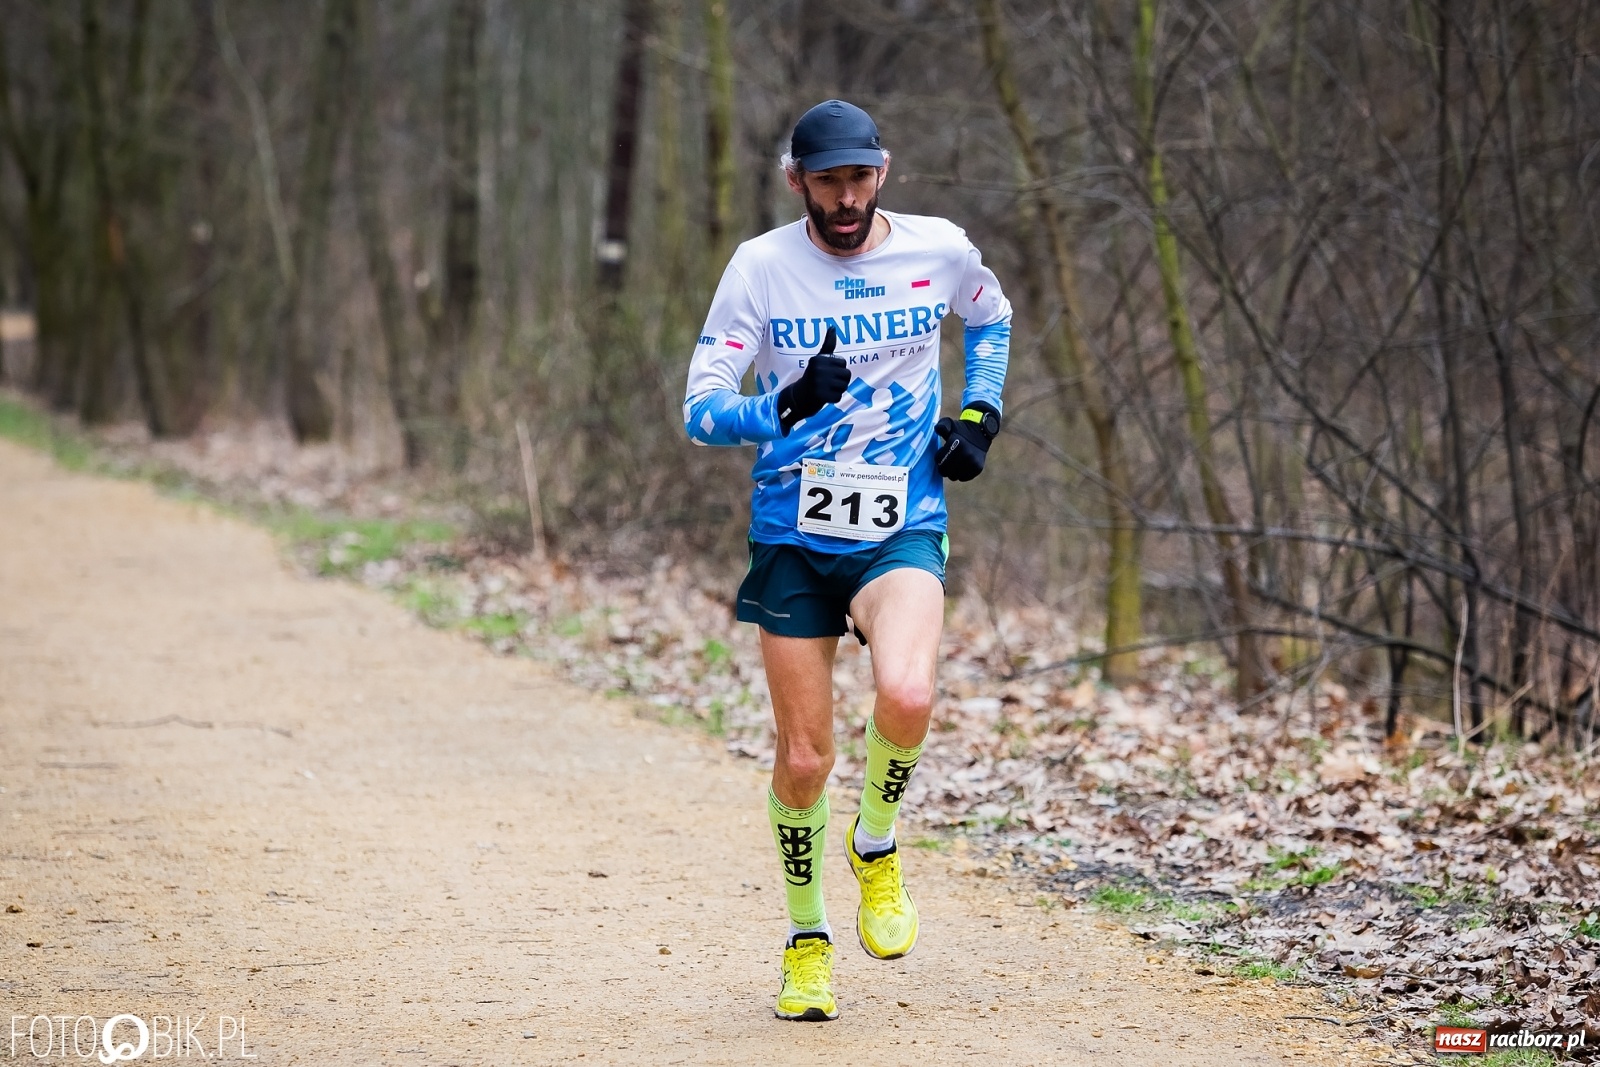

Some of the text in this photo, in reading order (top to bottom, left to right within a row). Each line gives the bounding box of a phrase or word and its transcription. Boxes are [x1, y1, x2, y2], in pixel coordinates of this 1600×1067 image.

[770, 303, 946, 349] RUNNERS
[849, 344, 926, 365] KNA TEAM
[804, 486, 899, 529] 213
